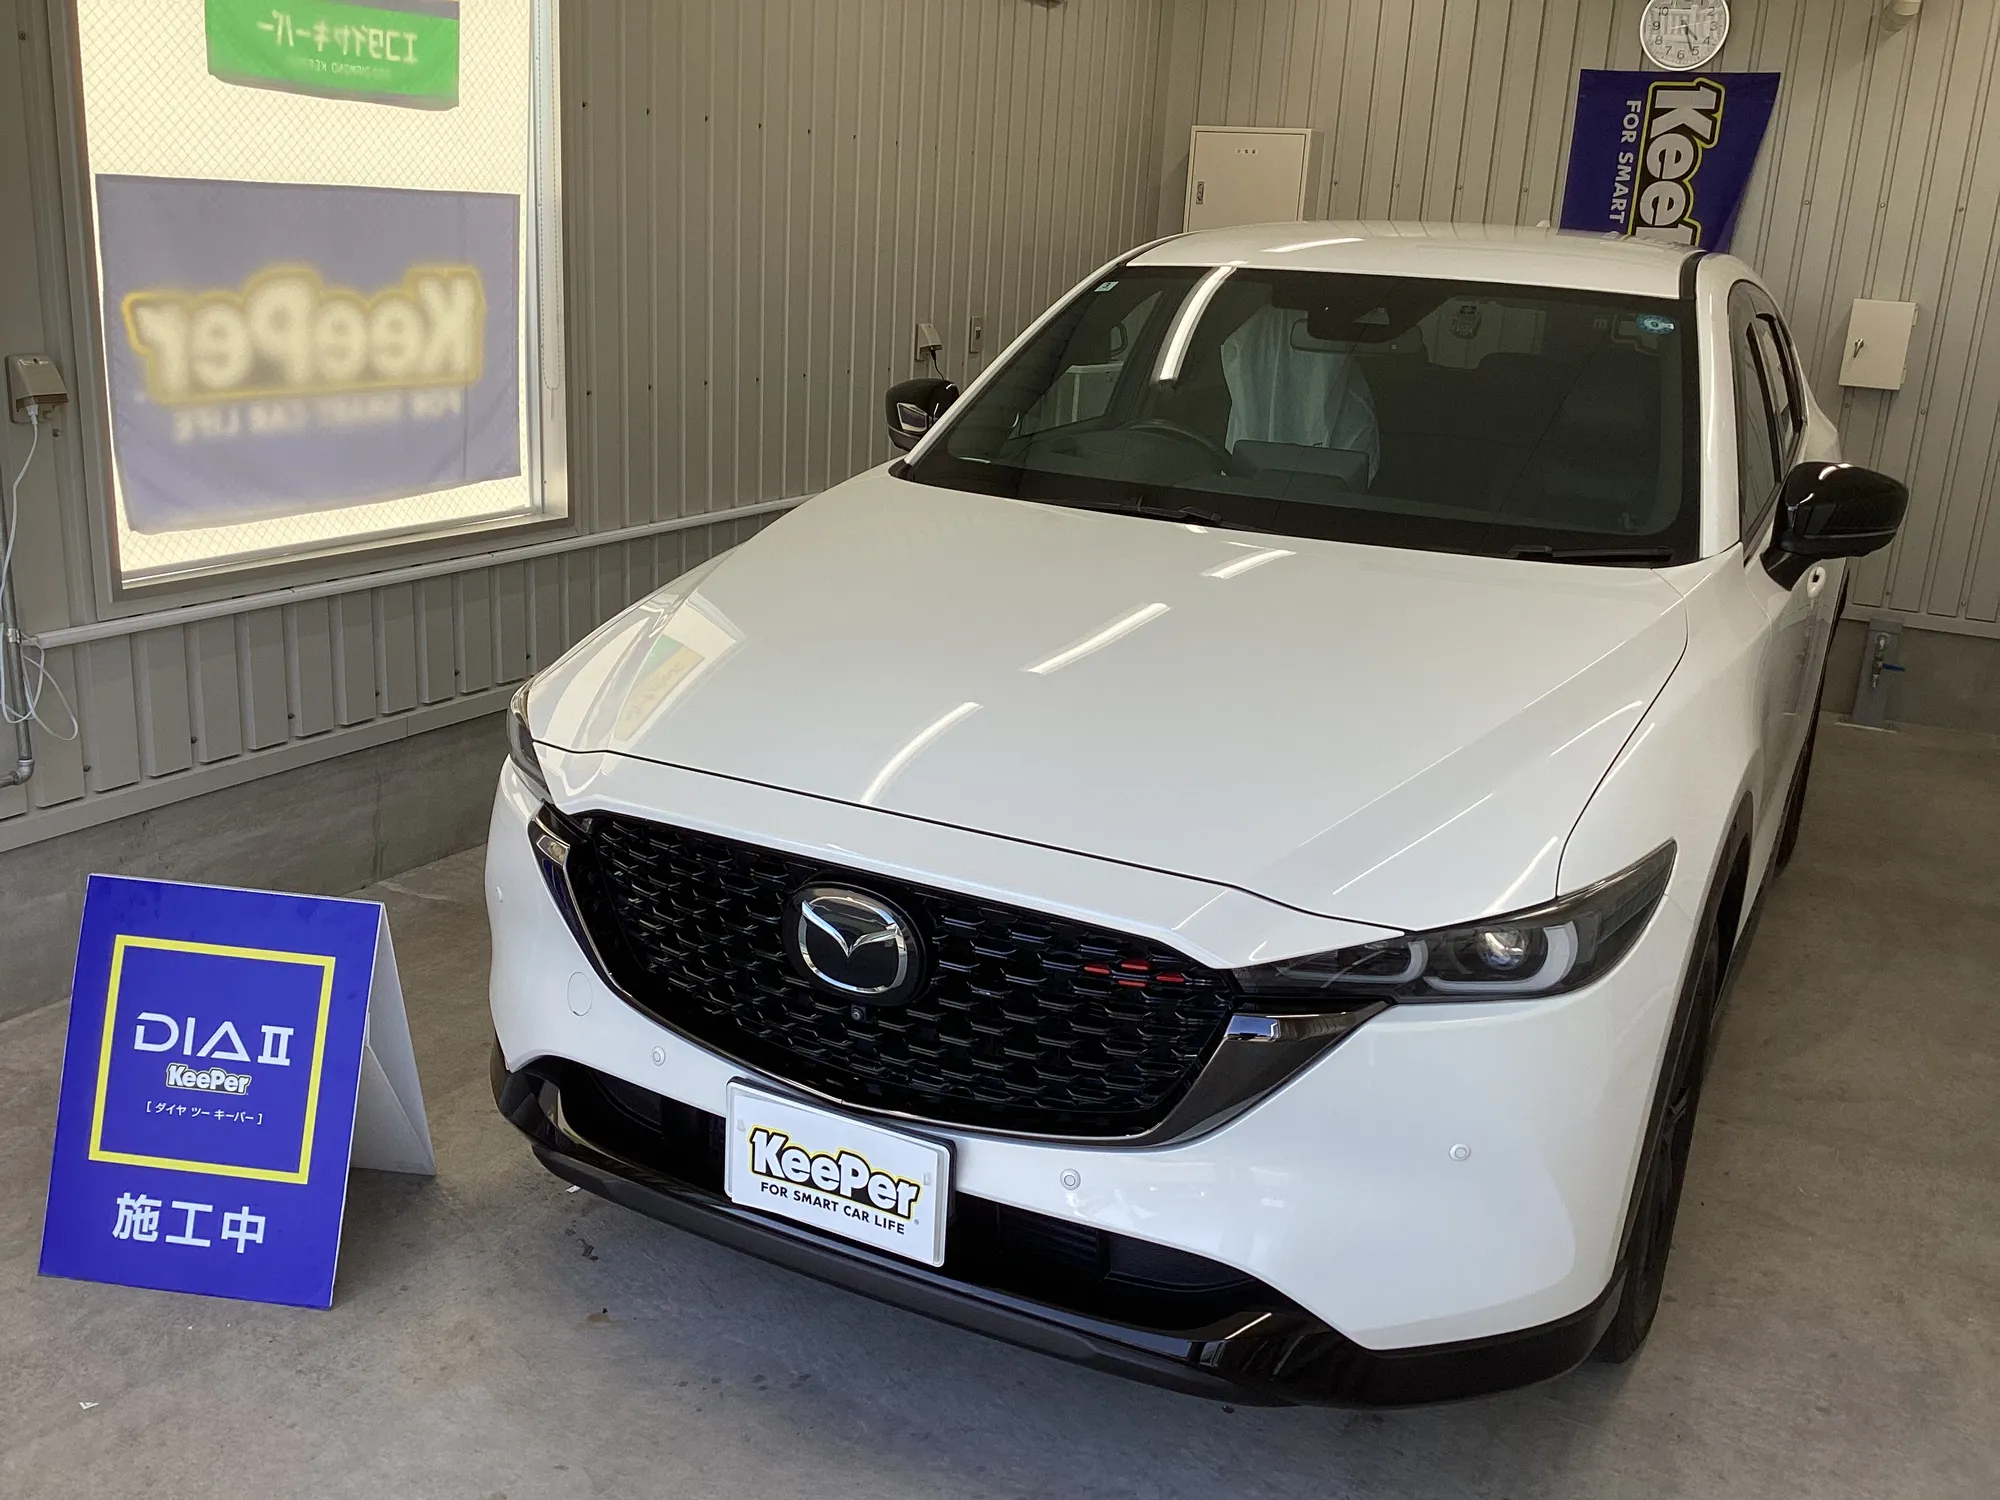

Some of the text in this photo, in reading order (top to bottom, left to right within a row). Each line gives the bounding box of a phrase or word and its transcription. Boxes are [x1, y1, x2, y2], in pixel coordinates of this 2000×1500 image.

[1706, 6, 1715, 17] 2
[1652, 21, 1661, 31] 9
[1710, 21, 1718, 31] 3
[1654, 36, 1663, 45] 8
[1702, 36, 1711, 45] 4
[1665, 46, 1673, 56] 7
[1677, 50, 1685, 60] 6
[1691, 46, 1700, 56] 5
[1609, 99, 1642, 225] FOR SMART
[133, 1011, 251, 1063] DIA
[165, 1062, 252, 1096] KeePer
[155, 1102, 187, 1116] ダイヤ
[191, 1106, 211, 1118] ツー
[750, 1126, 921, 1220] KeePer
[760, 1181, 905, 1235] FOR SMART CAR LIFE
[111, 1192, 267, 1254] 施工中
